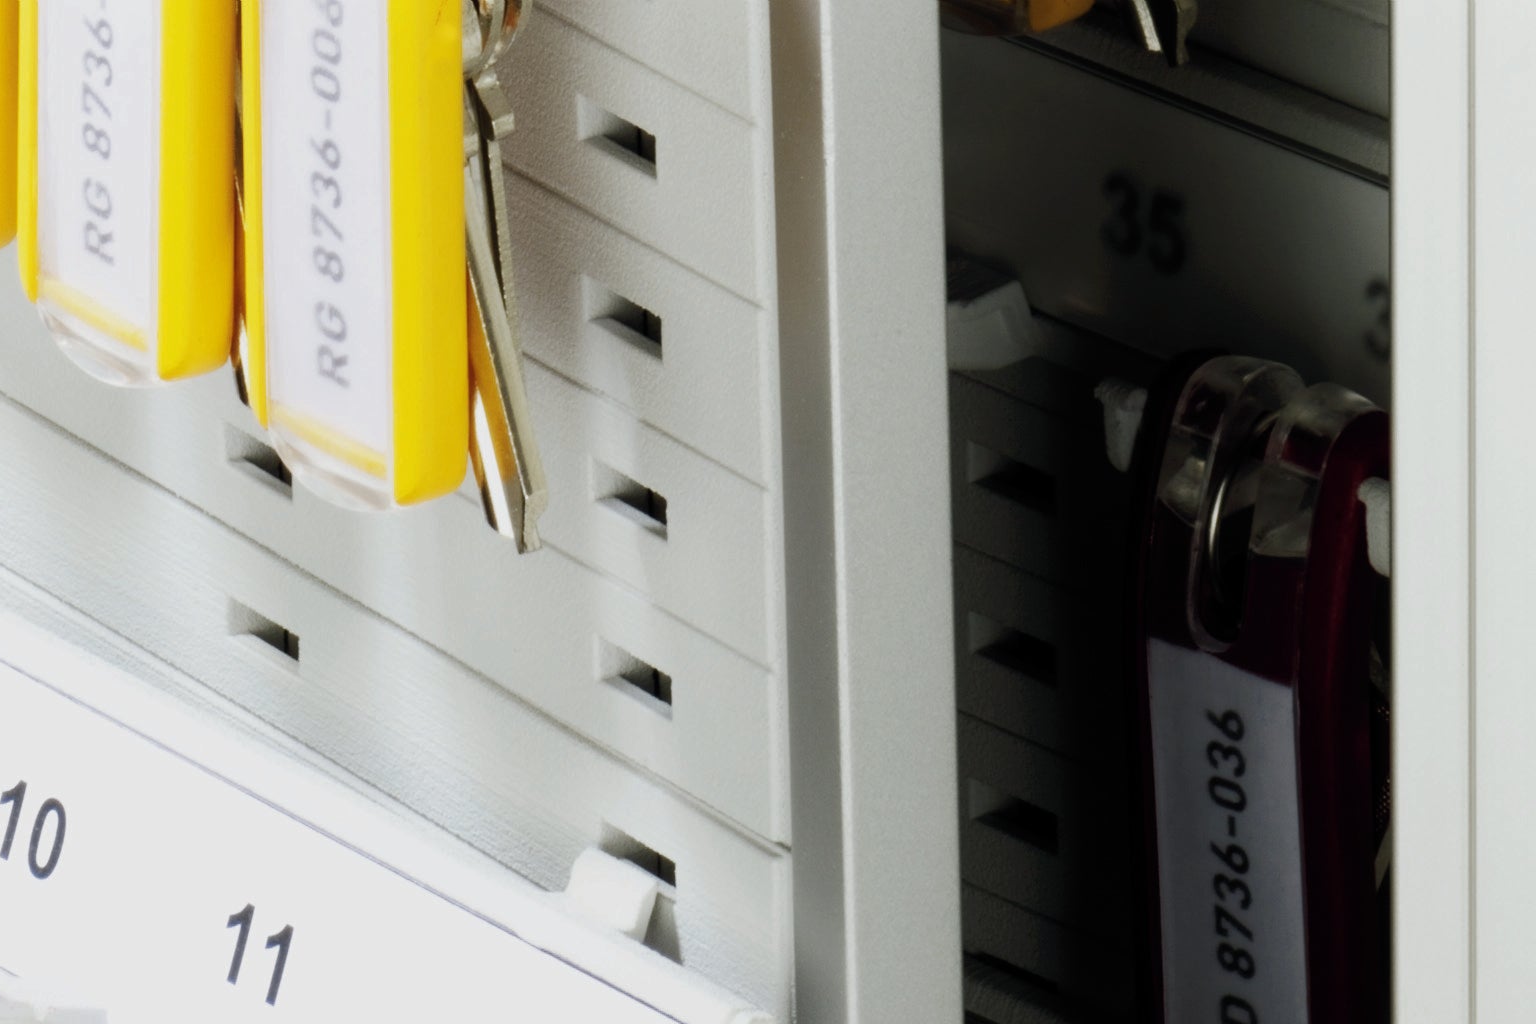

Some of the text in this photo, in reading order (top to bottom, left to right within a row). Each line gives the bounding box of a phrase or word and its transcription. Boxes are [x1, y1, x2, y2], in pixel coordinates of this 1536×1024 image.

[84, 178, 114, 264] RG
[1100, 170, 1186, 276] 35
[315, 302, 349, 387] RG
[1365, 279, 1387, 361] 3
[0, 781, 66, 879] 10
[1206, 710, 1256, 979] 8736-036
[227, 904, 293, 1005] 11
